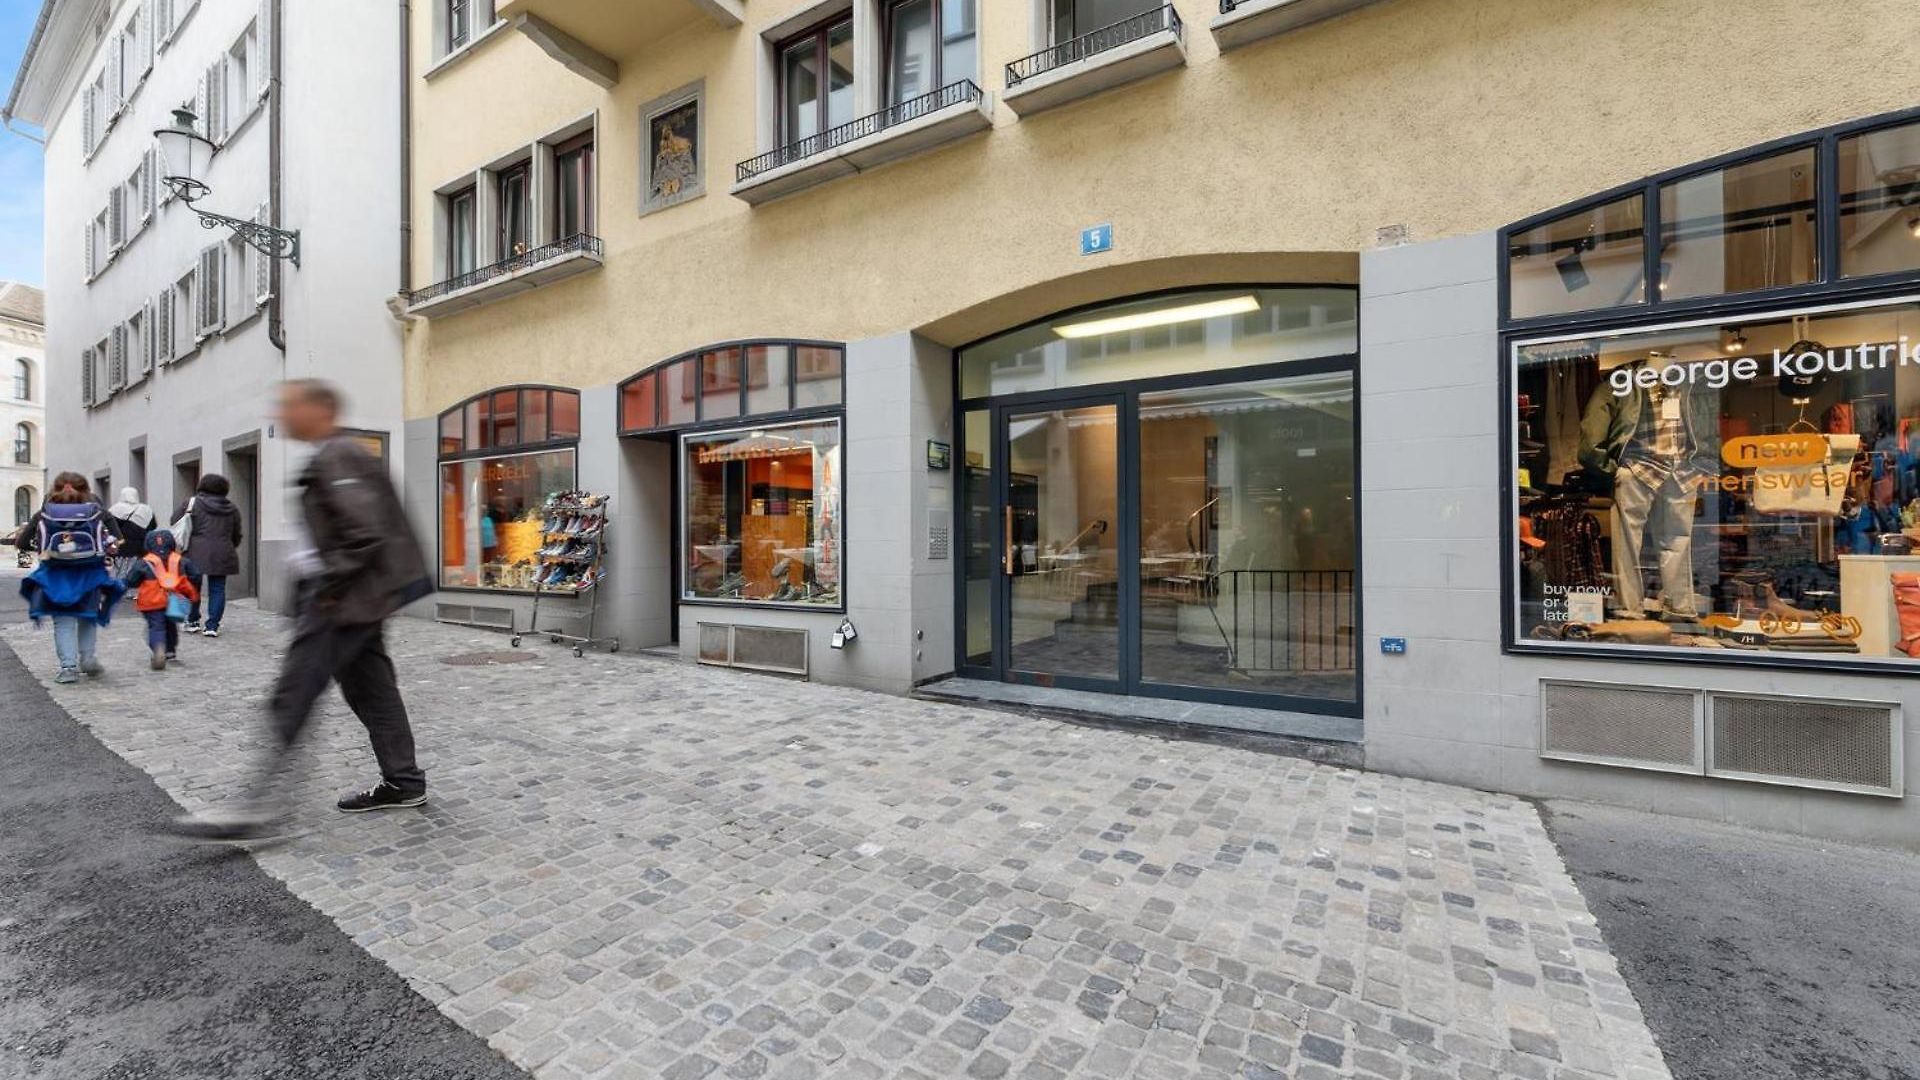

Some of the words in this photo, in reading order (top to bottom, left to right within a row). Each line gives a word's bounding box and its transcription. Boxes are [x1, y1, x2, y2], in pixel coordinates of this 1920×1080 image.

[1090, 229, 1101, 249] 5
[1609, 357, 1759, 398] george
[1740, 440, 1809, 460] new
[1694, 471, 1863, 492] menswear
[1543, 583, 1571, 597] buy
[1576, 585, 1611, 596] now
[1543, 598, 1560, 608] or
[1543, 609, 1568, 621] late
